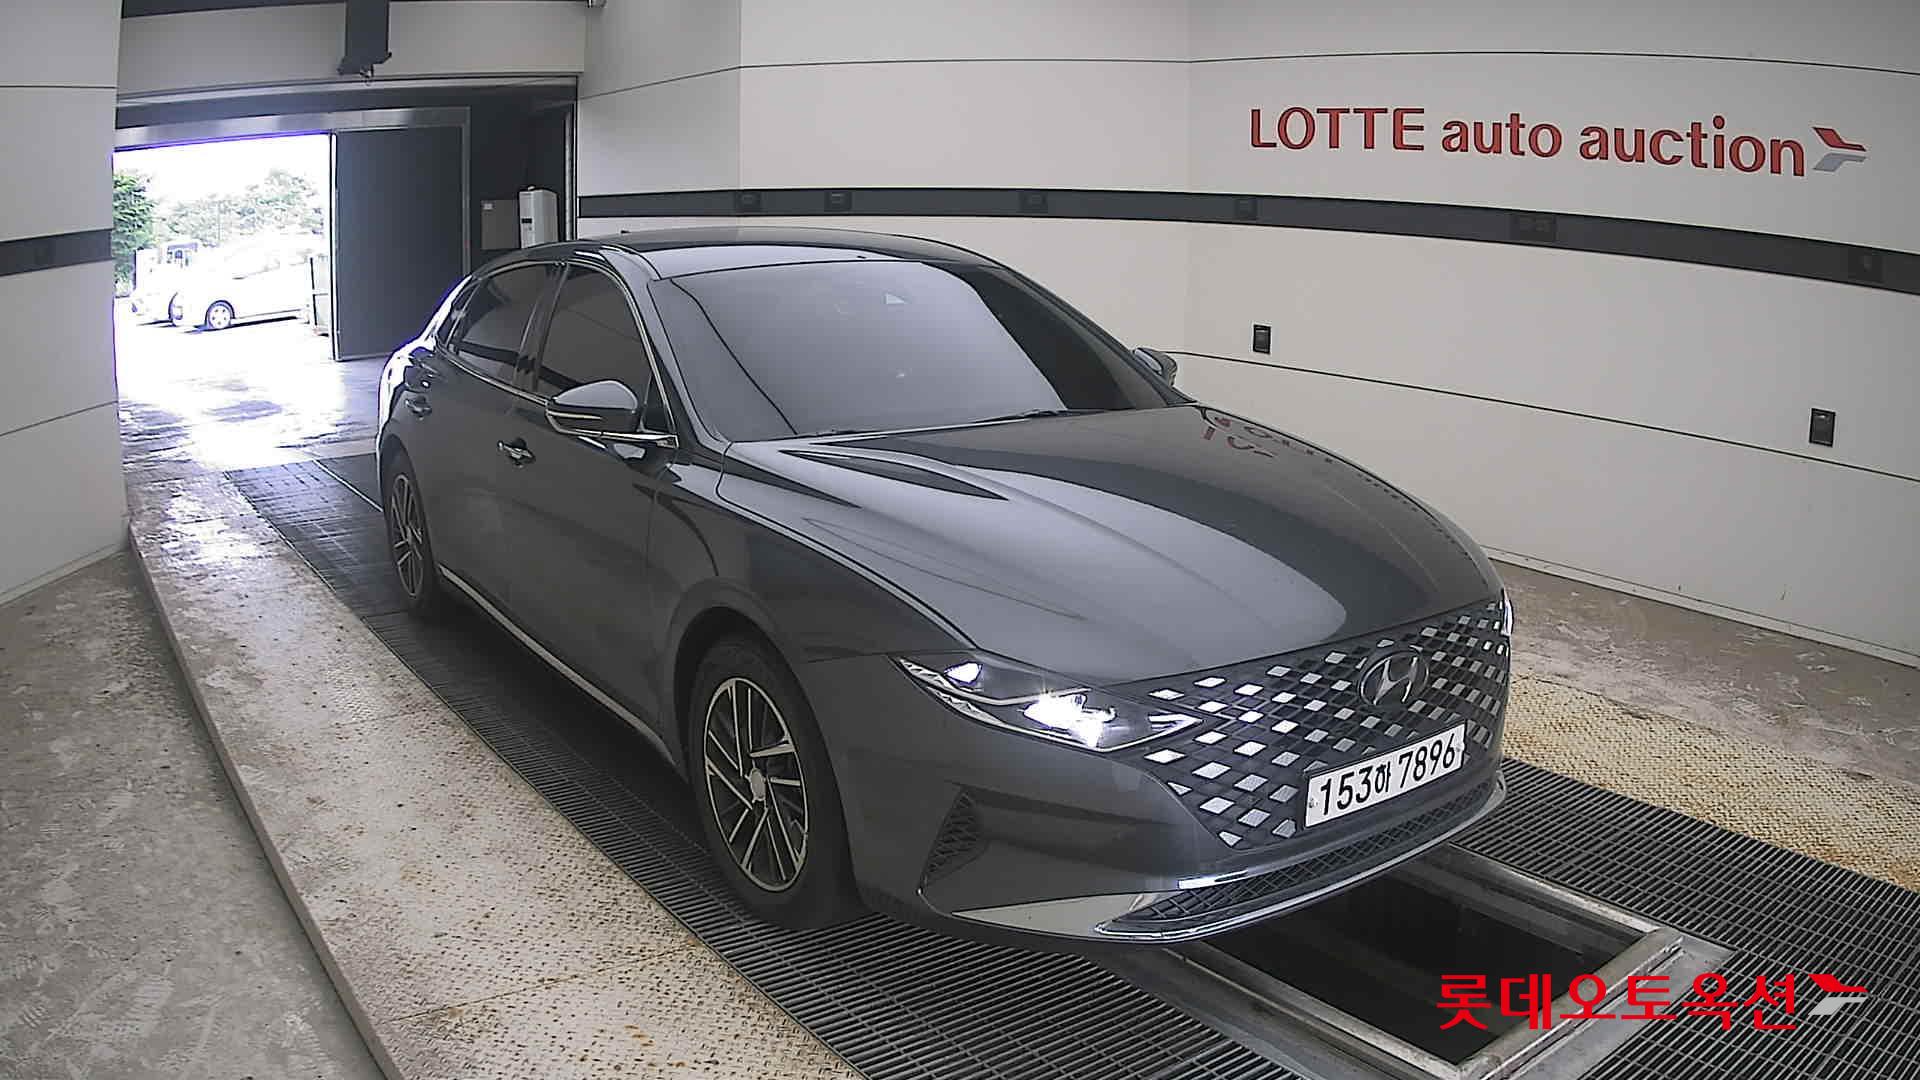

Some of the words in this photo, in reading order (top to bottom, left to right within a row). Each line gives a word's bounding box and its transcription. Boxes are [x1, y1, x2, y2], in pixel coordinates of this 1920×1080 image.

[1250, 107, 1425, 151] LOTTE
[1441, 112, 1563, 158] auto
[1579, 115, 1805, 177] auction
[1398, 733, 1456, 789] 7896
